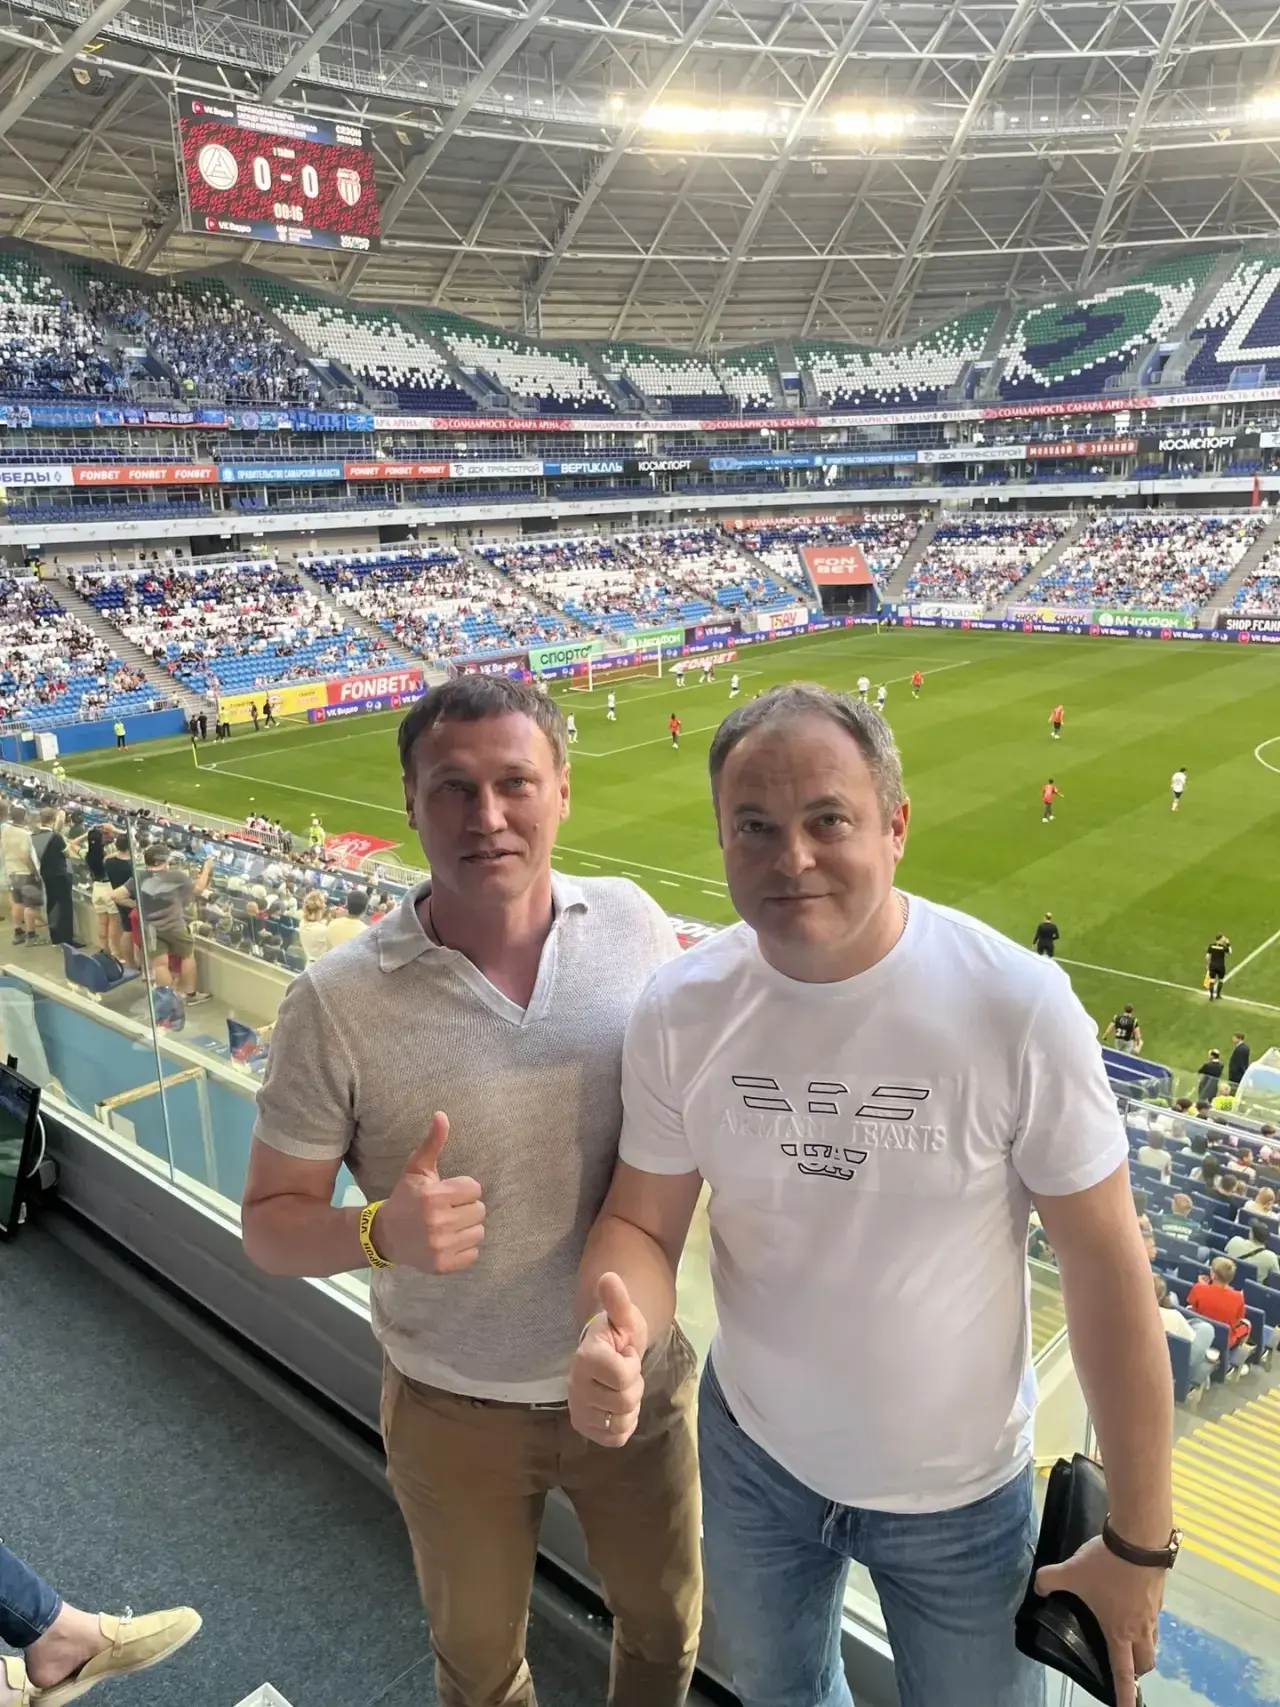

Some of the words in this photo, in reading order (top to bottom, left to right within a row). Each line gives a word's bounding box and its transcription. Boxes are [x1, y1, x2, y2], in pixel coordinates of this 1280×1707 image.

[253, 156, 272, 191] 0
[302, 164, 319, 199] 0
[273, 202, 304, 222] 00:16
[999, 404, 1065, 418] СОЛИДАРНОСТЬ
[1067, 401, 1104, 414] САМАРА
[448, 419, 507, 429] СОЛИДАРНОСТЬ
[508, 420, 537, 429] САМАРА
[717, 421, 779, 430] СОЛИДАРНОСТЬ
[781, 418, 816, 428] САМАРА
[1029, 444, 1073, 456] МОЛОДОЙ
[350, 466, 380, 476] FONBET
[384, 466, 414, 476] FONBET
[418, 465, 446, 475] FONBET
[561, 461, 624, 474] ВЕРТИКАЛЬ
[0, 471, 50, 484] БЕДЫ
[79, 470, 121, 480] FONBET
[128, 469, 167, 480] FONBET
[174, 468, 212, 479] FONBET
[863, 513, 907, 523] СЕКТОР
[813, 557, 855, 566] FON
[816, 564, 859, 575] BET
[340, 674, 410, 701] FONBET
[851, 1120, 949, 1153] JEANS
